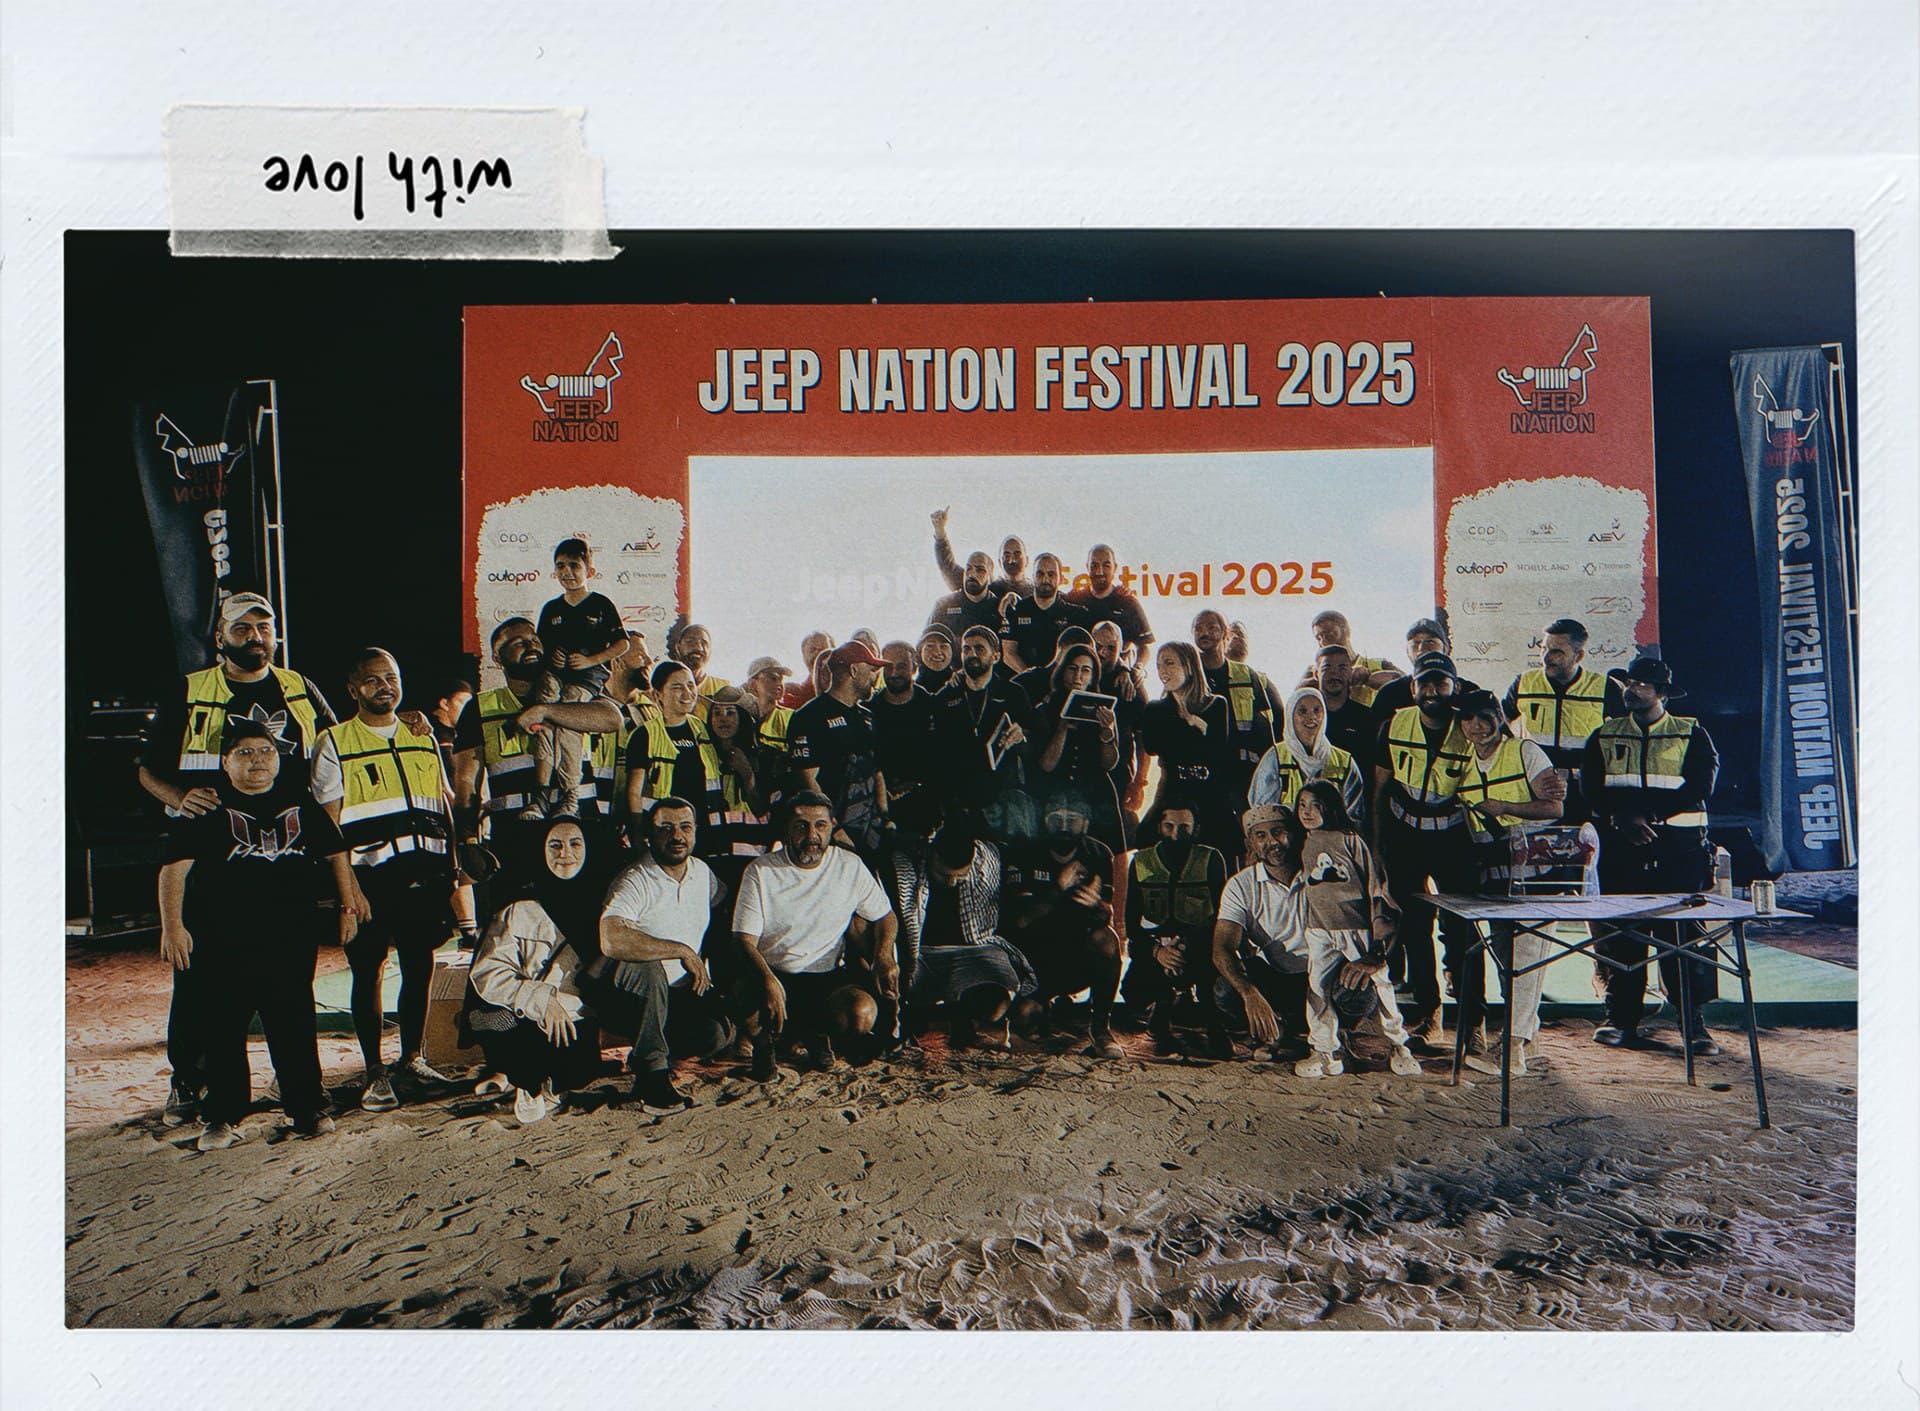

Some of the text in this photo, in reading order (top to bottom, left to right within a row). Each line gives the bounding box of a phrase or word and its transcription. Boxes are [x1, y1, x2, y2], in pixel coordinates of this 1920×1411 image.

[698, 340, 1416, 413] JEEP NATION FESTIVAL 2025
[548, 399, 606, 421] JEEP
[1525, 392, 1581, 414] JEEP
[532, 420, 619, 442] NATION
[1510, 412, 1595, 433] NATION
[487, 569, 538, 586] autopro
[1060, 560, 1334, 597] Fetival 2025
[1456, 561, 1506, 578] autopro
